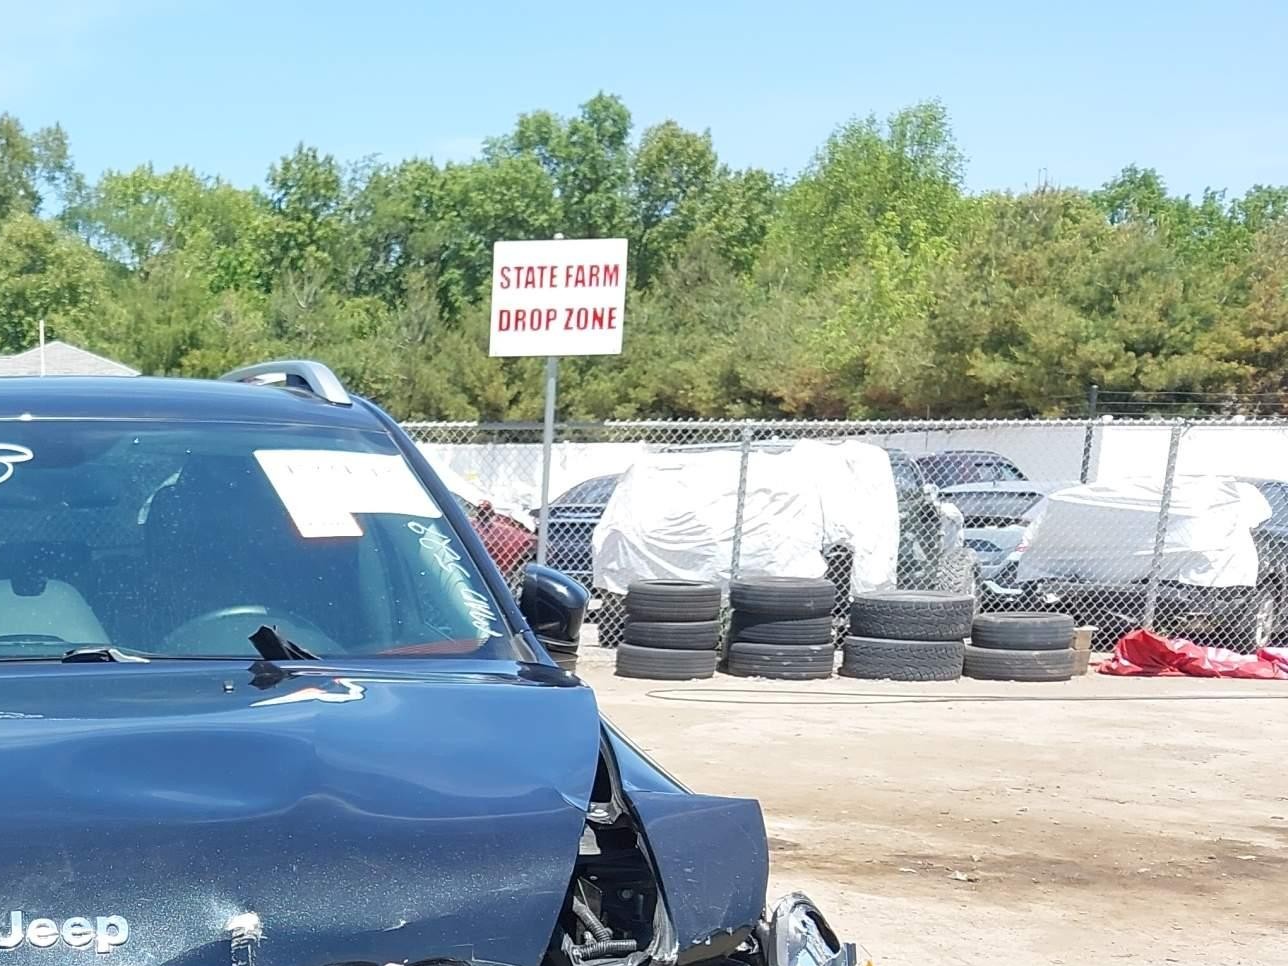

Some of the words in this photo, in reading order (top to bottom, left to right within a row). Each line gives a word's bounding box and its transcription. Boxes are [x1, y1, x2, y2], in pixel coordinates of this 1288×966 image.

[500, 265, 558, 289] STATE
[564, 264, 620, 288] FARM
[498, 308, 557, 332] DROP
[563, 306, 617, 330] ZONE
